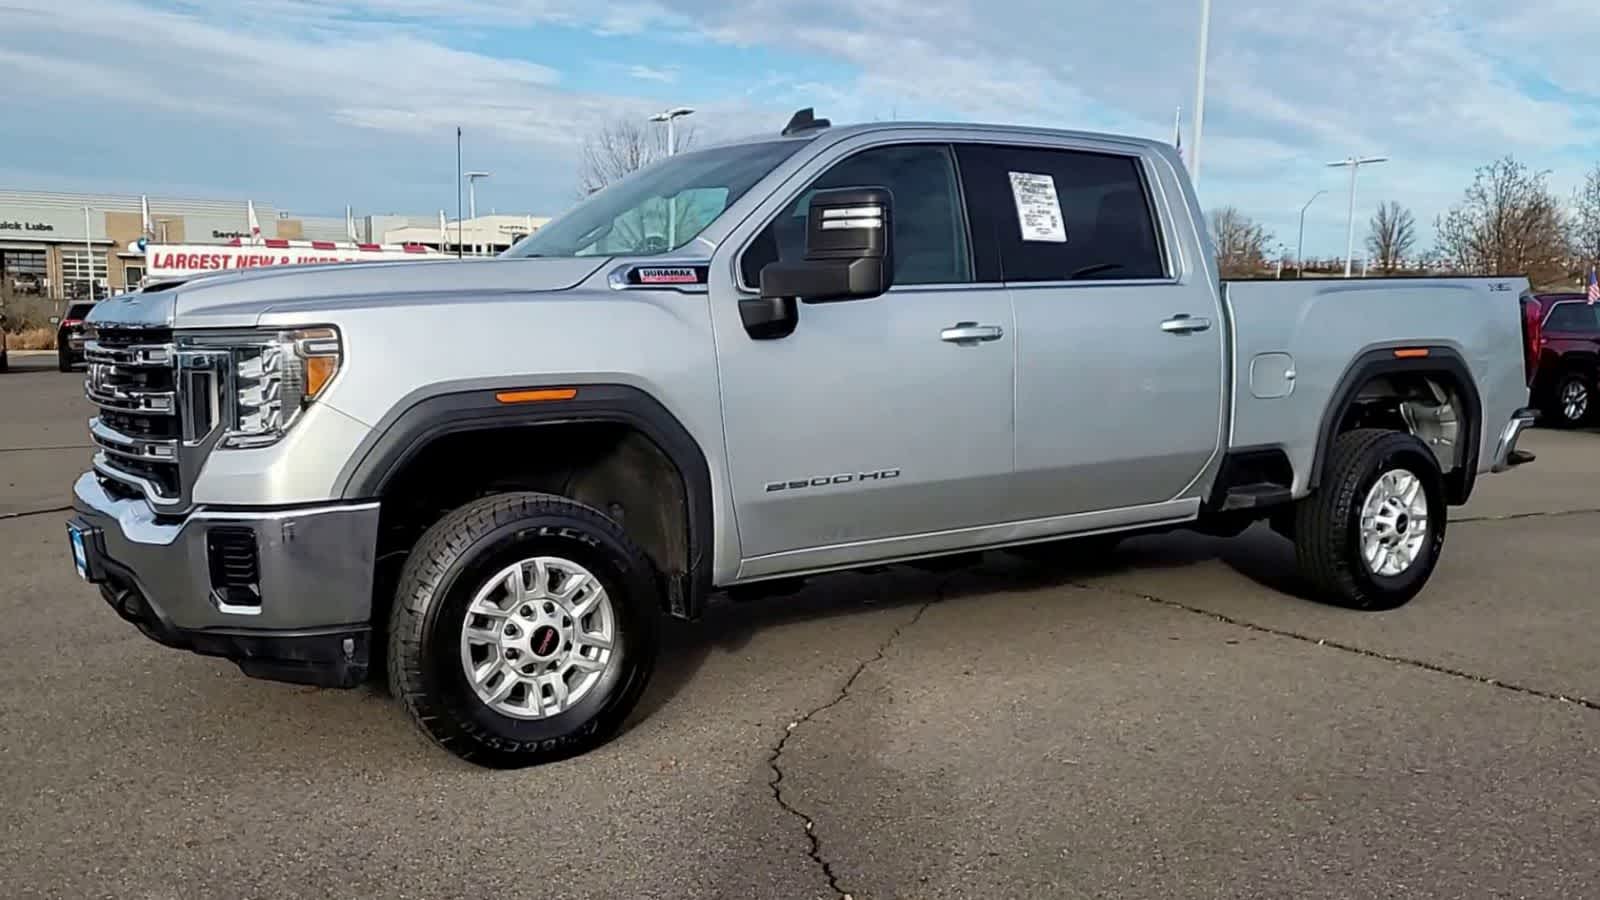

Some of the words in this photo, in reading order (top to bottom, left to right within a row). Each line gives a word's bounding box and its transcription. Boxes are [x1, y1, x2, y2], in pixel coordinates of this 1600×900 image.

[25, 222, 53, 231] Lube
[153, 252, 232, 270] LARGEST
[236, 254, 275, 268] NEW
[642, 269, 692, 277] DURAMAX
[766, 473, 853, 492] 2500
[859, 468, 900, 481] HD
